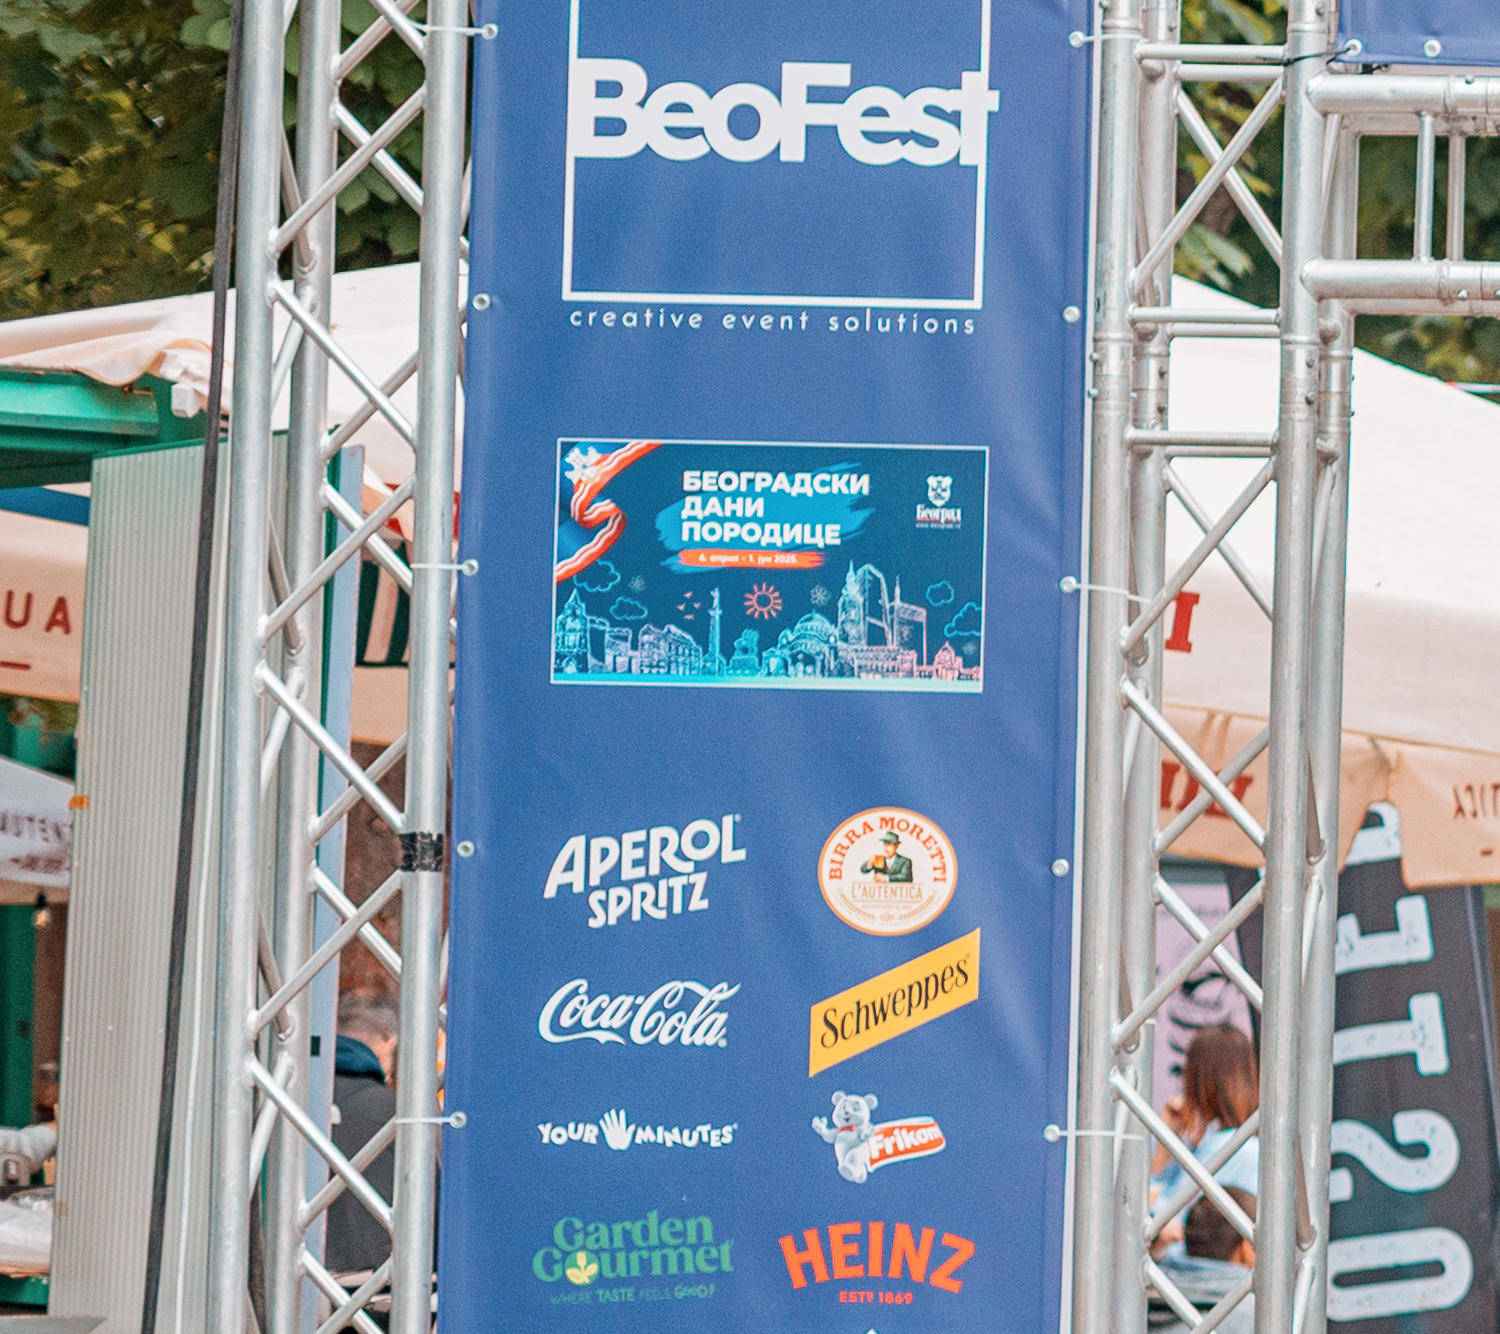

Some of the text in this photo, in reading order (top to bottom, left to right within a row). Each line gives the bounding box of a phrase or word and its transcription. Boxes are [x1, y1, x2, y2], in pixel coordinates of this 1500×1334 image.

[572, 57, 1001, 168] BeoFest
[570, 307, 977, 338] creative event solutions
[683, 470, 870, 497] БЕОГРАДСКИ
[681, 495, 765, 520] ДАНИ
[681, 521, 842, 549] ПОРОДИЦЕ
[543, 813, 747, 899] APEROL
[828, 816, 948, 884] BIRRA MORETTI
[588, 871, 709, 929] SPRITZ
[851, 884, 922, 900] L'AUTENTICA
[538, 978, 741, 1048] Coca-Cola
[820, 955, 971, 1050] Schweppes
[537, 1122, 735, 1148] YOUR MINUTES
[869, 1124, 942, 1161] Frikom
[553, 1209, 714, 1253] Garden
[532, 1239, 735, 1285] Gourmet
[779, 1221, 976, 1294] HEINZ
[596, 1287, 634, 1302] TASTE
[878, 1291, 913, 1305] 1869
